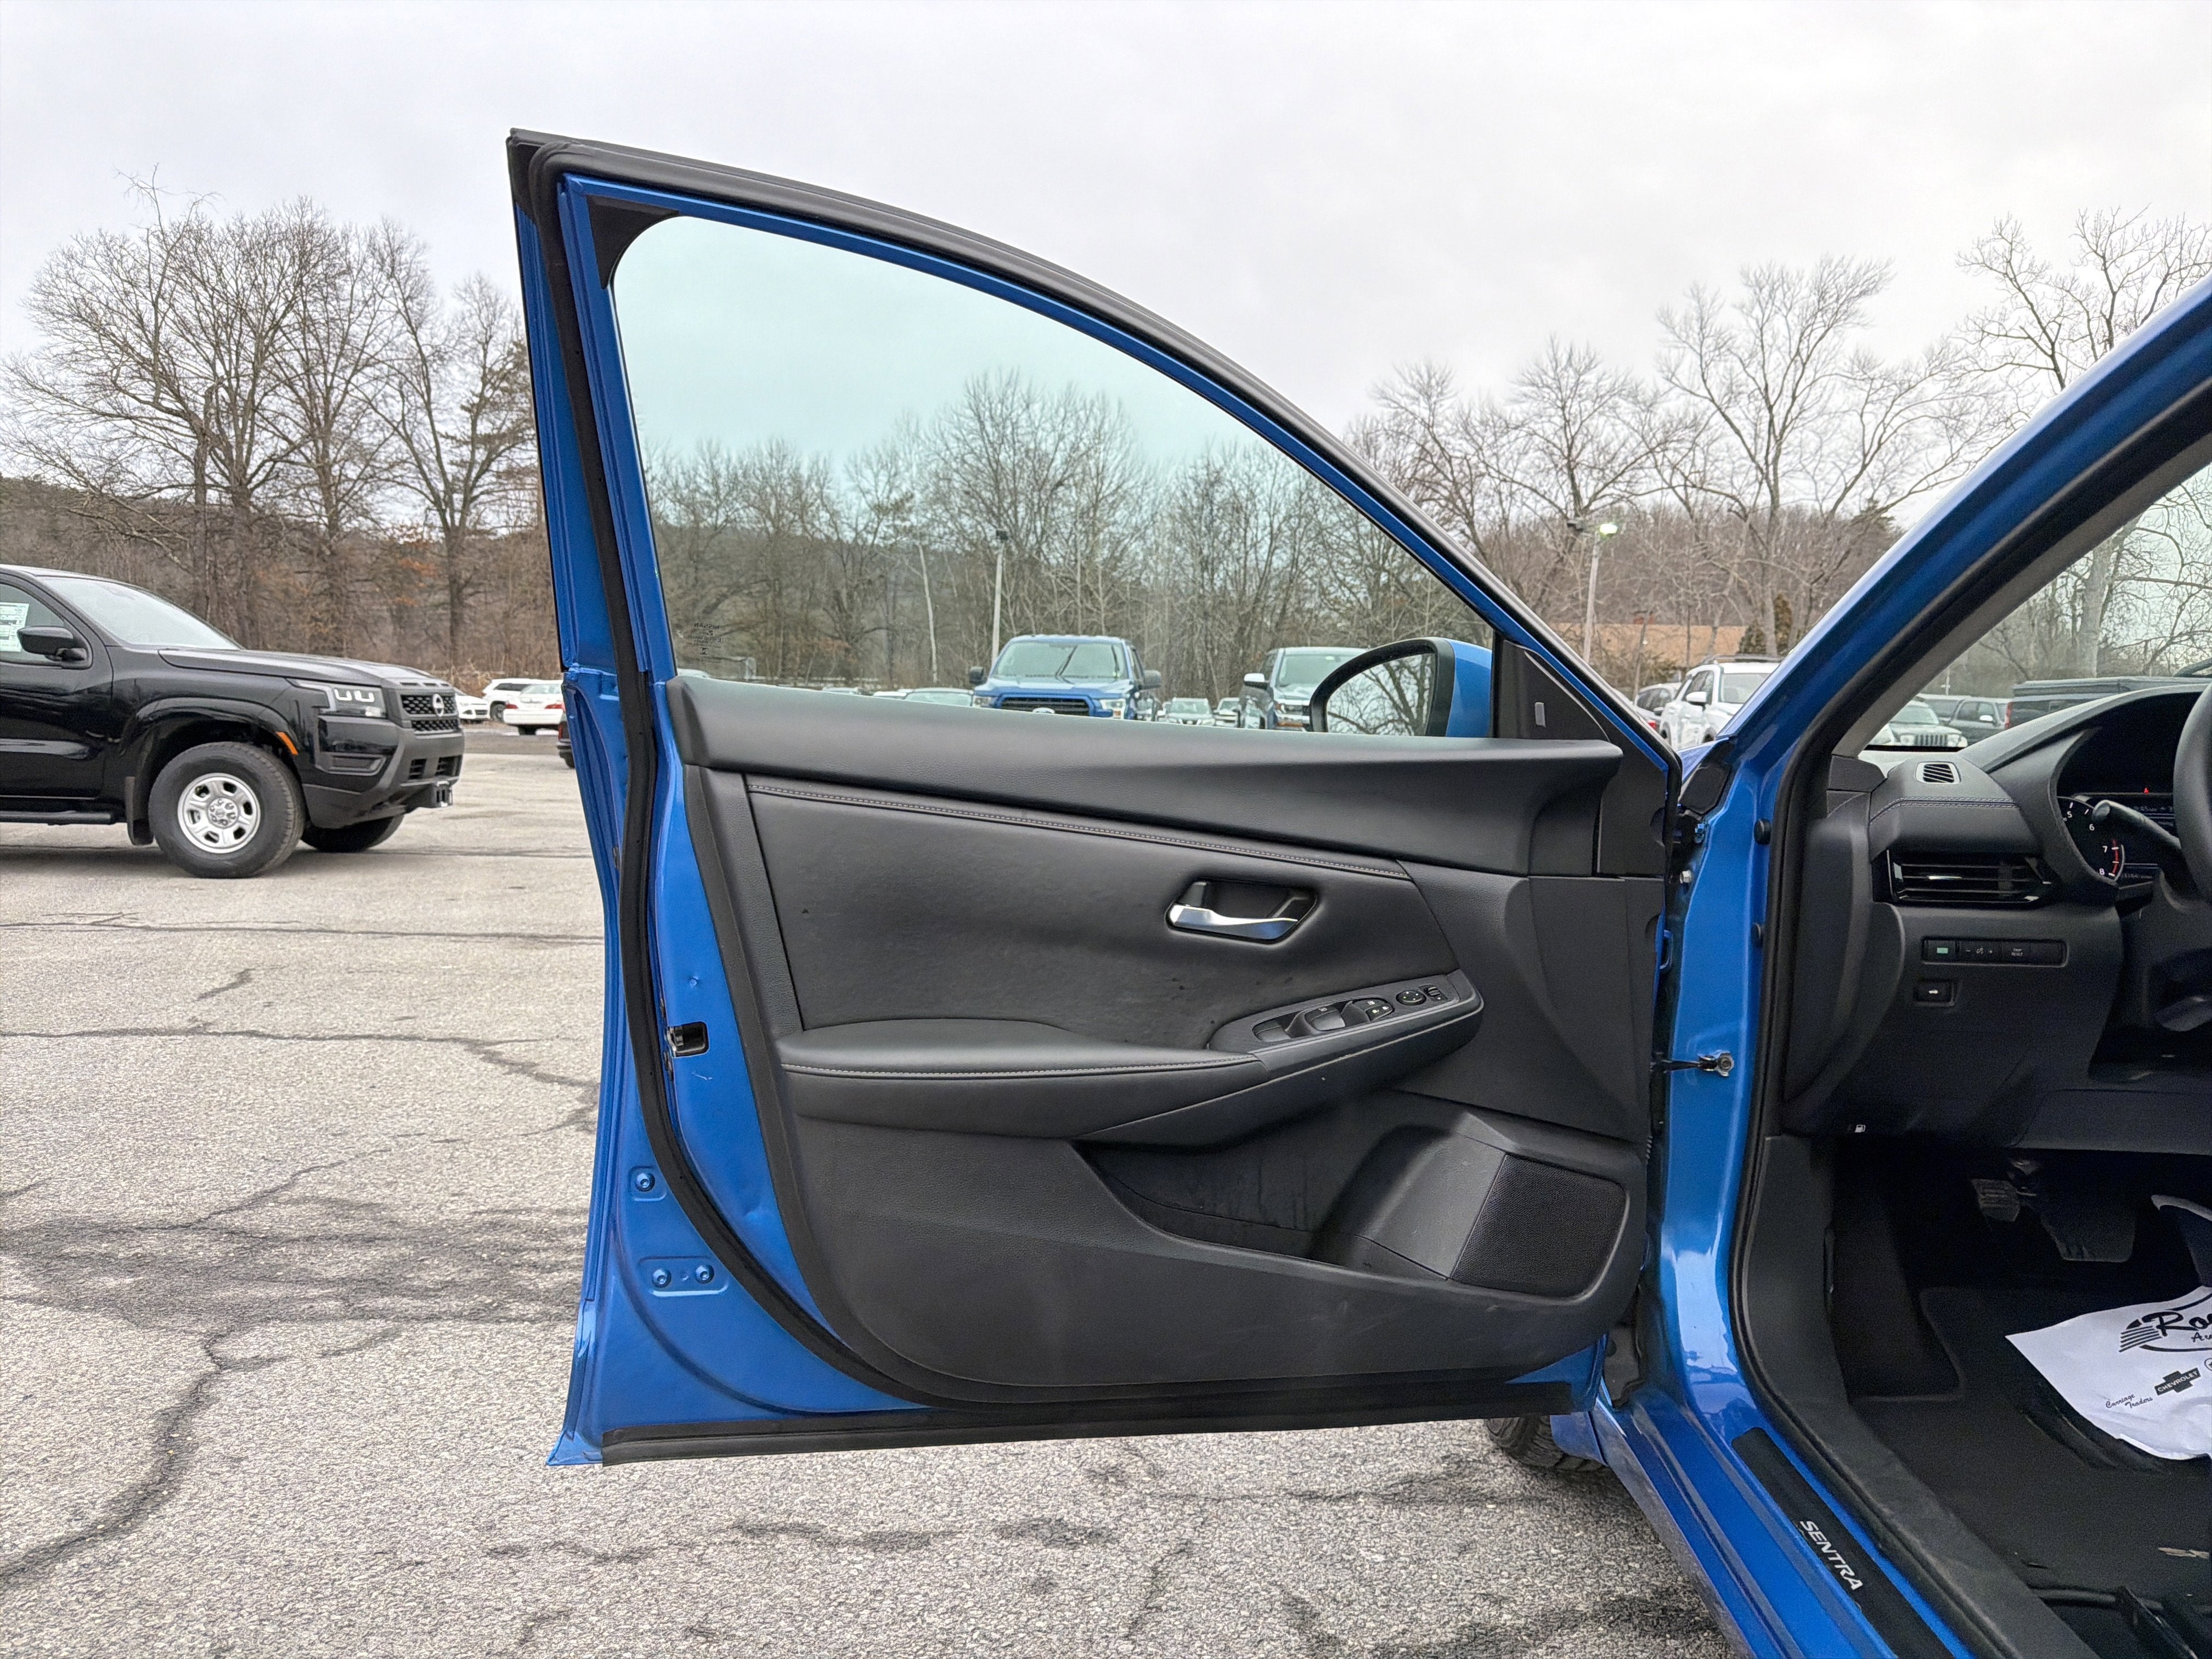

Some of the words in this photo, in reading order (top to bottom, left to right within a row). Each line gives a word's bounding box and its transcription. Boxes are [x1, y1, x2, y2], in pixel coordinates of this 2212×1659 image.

[2157, 1371, 2198, 1392] CHEVROLET
[2106, 1394, 2135, 1408] Carriage
[2124, 1397, 2153, 1409] Traders
[1799, 1521, 1863, 1590] SENTRA
